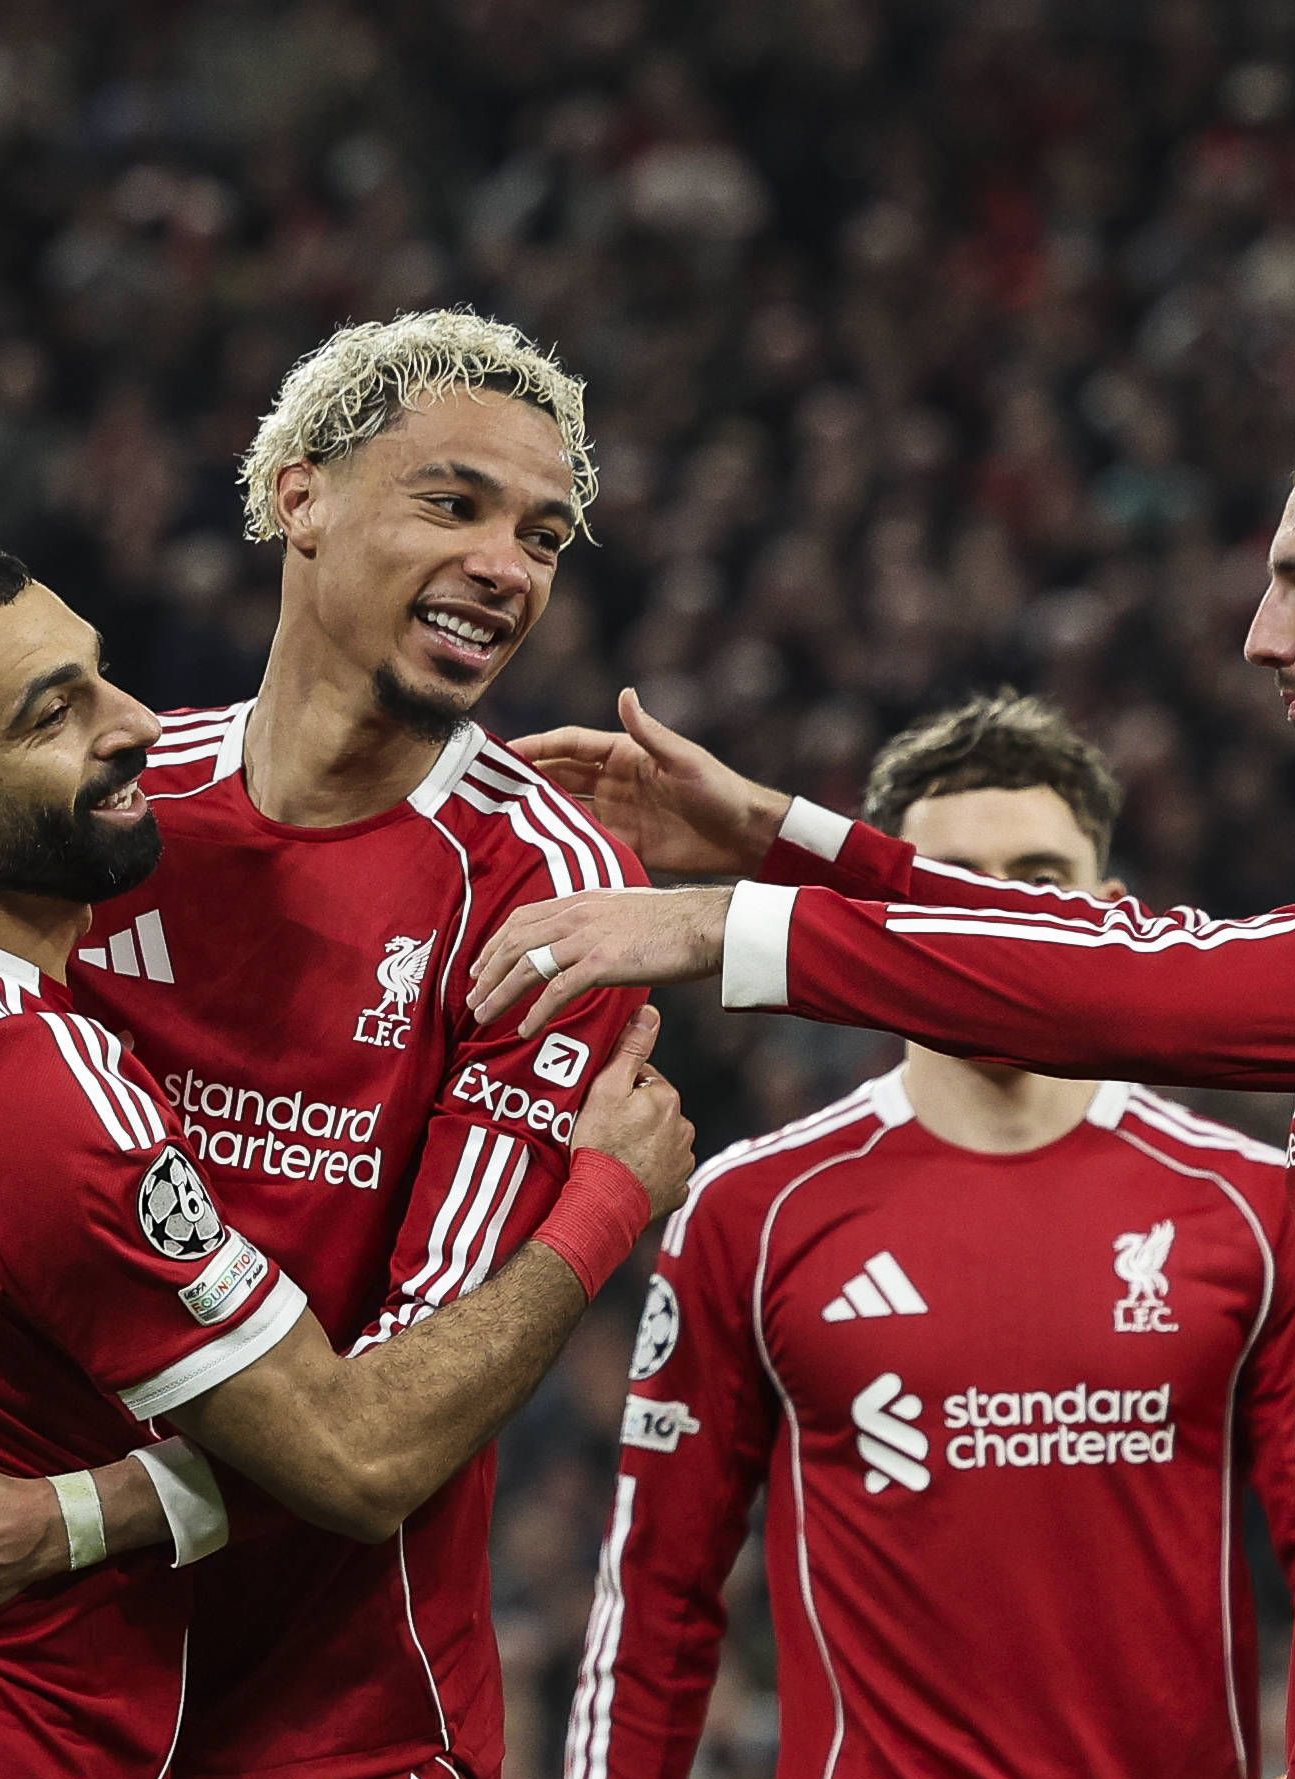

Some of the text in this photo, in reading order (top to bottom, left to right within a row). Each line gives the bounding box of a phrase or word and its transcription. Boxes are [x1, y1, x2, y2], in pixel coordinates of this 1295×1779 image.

[165, 1068, 382, 1144] standard
[943, 1382, 1170, 1428] standard
[946, 1423, 1176, 1470] chartered
